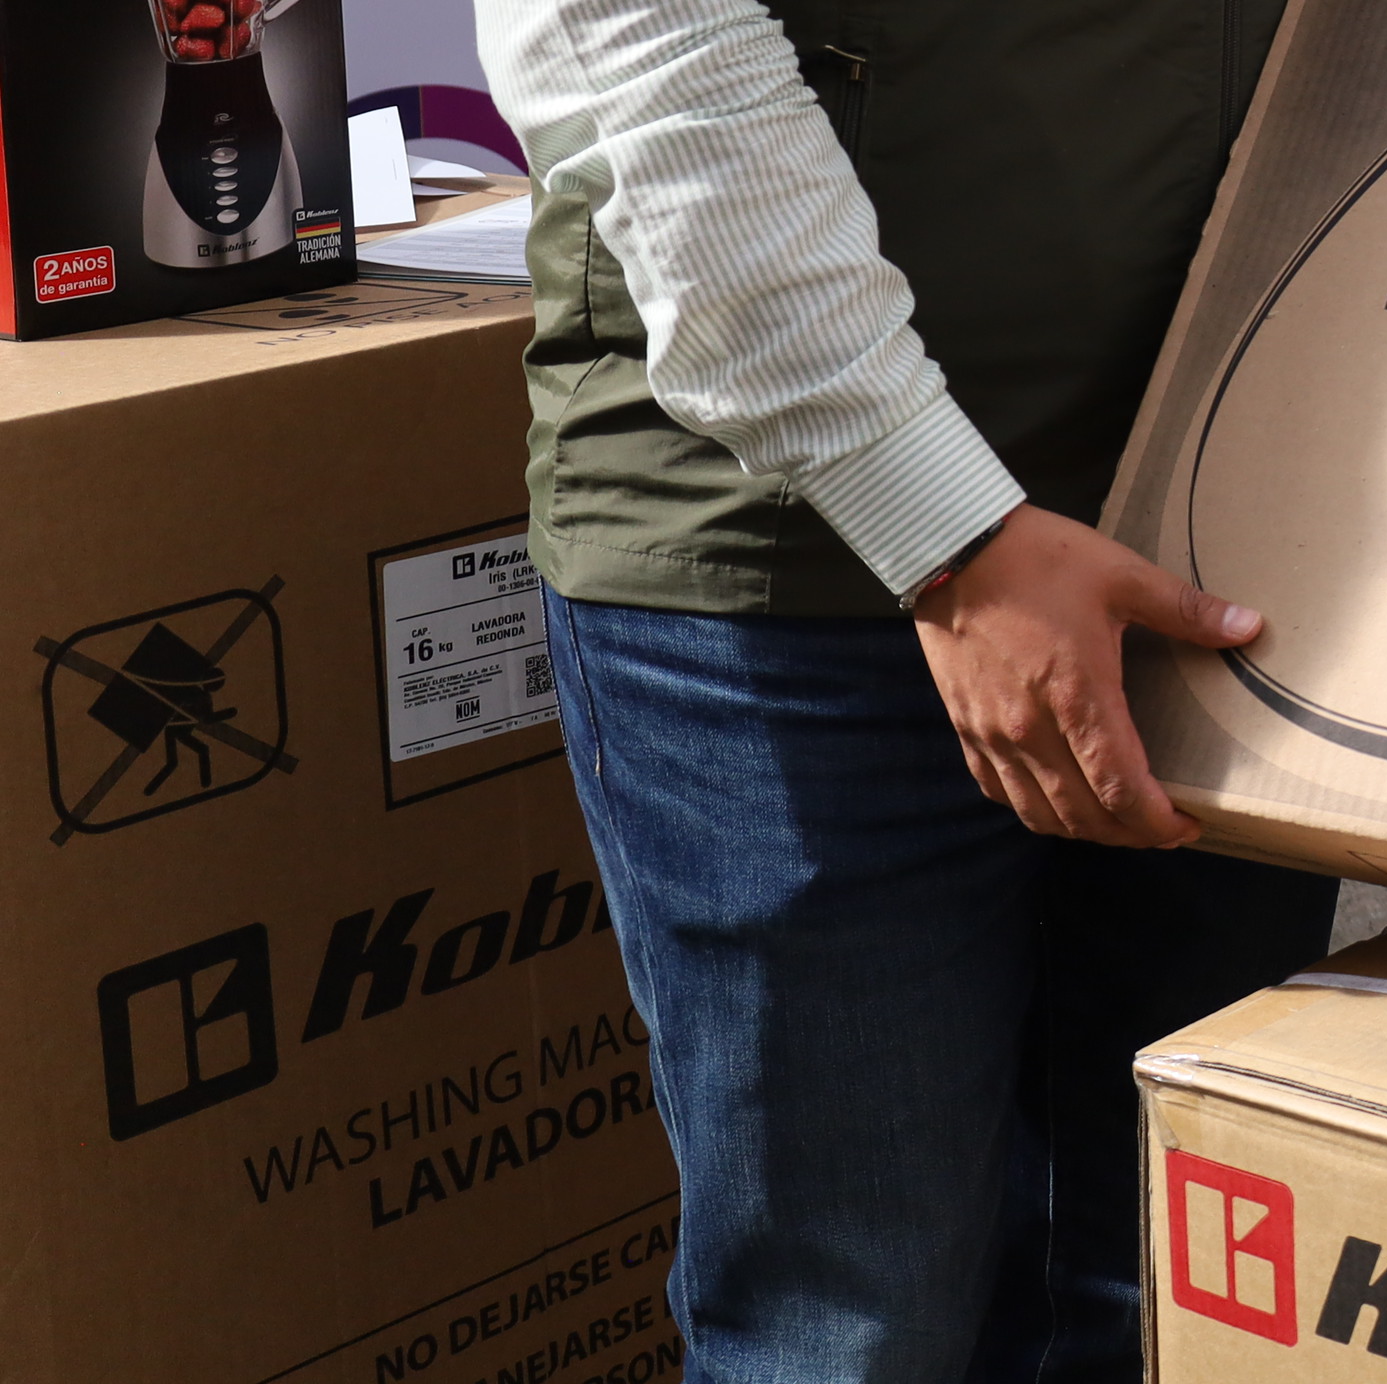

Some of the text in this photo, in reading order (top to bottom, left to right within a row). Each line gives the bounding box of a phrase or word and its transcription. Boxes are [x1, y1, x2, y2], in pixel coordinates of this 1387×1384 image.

[296, 233, 342, 253] TRADICIÓN
[43, 255, 108, 281] 2 AÑOS
[299, 250, 341, 264] ALEMANA
[39, 274, 108, 296] de garantía
[479, 547, 531, 571] Kobl
[488, 571, 507, 585] Iris
[411, 626, 431, 639] CAP.
[471, 611, 526, 633] LAVADORA
[476, 625, 525, 646] REDONDA
[403, 638, 453, 665] 16 kg
[456, 699, 480, 720] NOM
[302, 869, 613, 1044] Kob
[243, 1053, 523, 1204] WASHING
[374, 1333, 438, 1384] NO
[449, 1247, 612, 1356] DEJARSE
